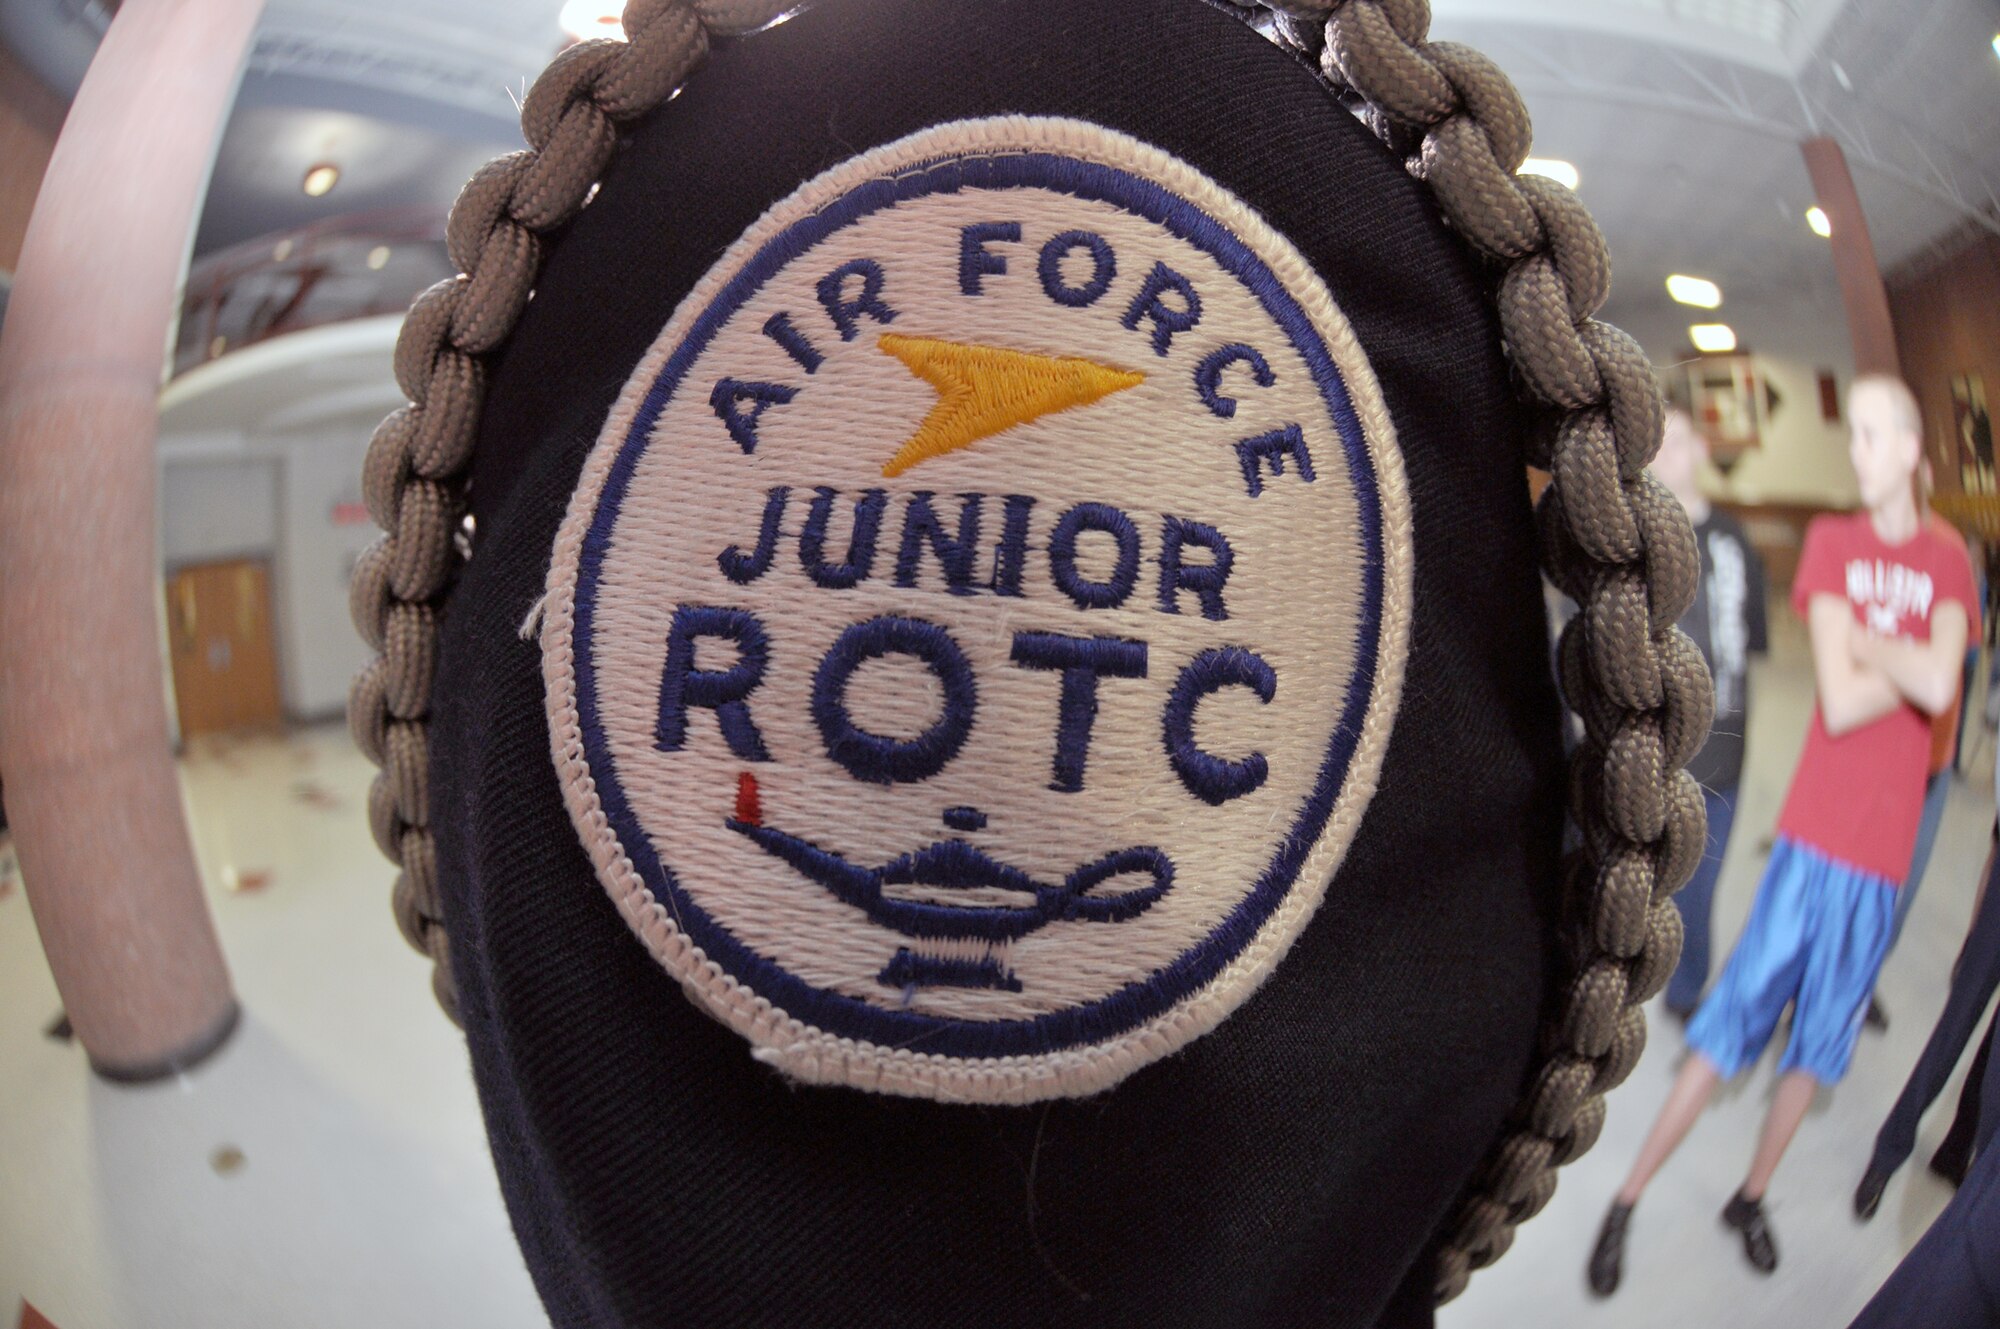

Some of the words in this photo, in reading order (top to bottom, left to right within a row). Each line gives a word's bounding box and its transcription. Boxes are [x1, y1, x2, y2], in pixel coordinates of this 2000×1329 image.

[708, 258, 900, 455] AIR
[957, 221, 1317, 498] FORCE
[715, 484, 1236, 622] JUNIOR
[651, 601, 1277, 807] ROTC
